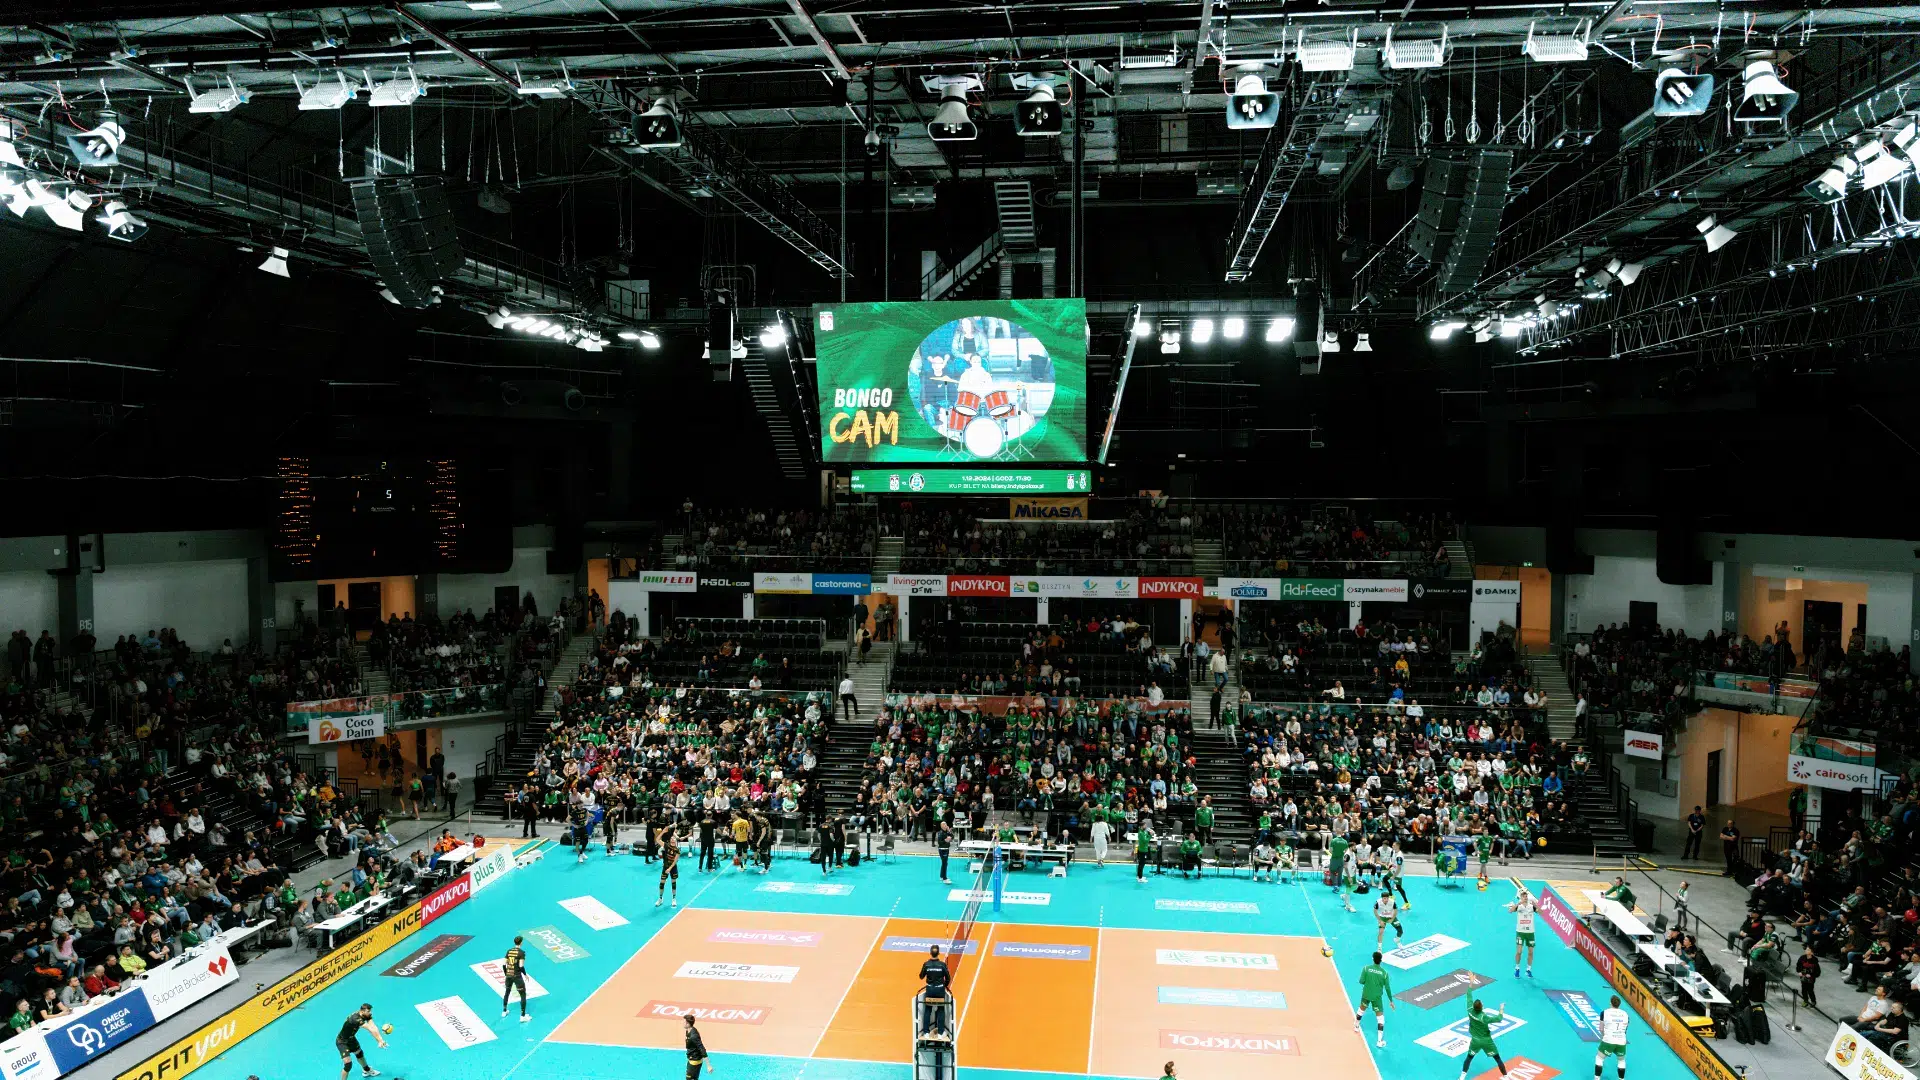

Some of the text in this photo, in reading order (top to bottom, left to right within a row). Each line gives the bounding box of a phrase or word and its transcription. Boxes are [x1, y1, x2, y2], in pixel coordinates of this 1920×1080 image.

[834, 388, 892, 407] BONGO
[829, 410, 899, 448] CAM
[386, 489, 392, 499] 5
[1015, 501, 1083, 518] MIKASA
[815, 580, 862, 589] castorama
[893, 577, 941, 587] livingroom
[951, 580, 1007, 592] INDYKPOL
[1141, 581, 1200, 594] INDYKPOL
[1231, 588, 1266, 597] POLMLEK
[1354, 586, 1405, 595] szynakameble
[262, 618, 275, 629] B15
[1724, 611, 1736, 622] B4
[79, 619, 93, 631] B15
[346, 718, 374, 728] Coco
[346, 729, 374, 738] Palm
[1627, 739, 1659, 752] ABER
[1815, 769, 1869, 784] cairosoft
[473, 863, 495, 887] plus
[422, 881, 470, 921] INDYKPOL
[393, 908, 422, 935] NICE
[1548, 904, 1575, 936] TAURON
[716, 931, 789, 941] TAURON
[1203, 955, 1269, 967] plus
[1576, 930, 1613, 976] INDYKPOL
[262, 935, 375, 1007] CATERING DIETETYCZNY
[153, 970, 211, 1005] Suporta Brokers
[277, 952, 364, 1011] Z WYBOREM MENU
[1615, 967, 1629, 989] TO
[1630, 981, 1647, 1008] FIT
[101, 1008, 131, 1027] OMEGA
[652, 1004, 764, 1020] INDYKPOL
[104, 1018, 127, 1034] LAKE
[1168, 1033, 1290, 1050] INDYKPOL
[11, 1051, 39, 1072] GROUP
[158, 1045, 194, 1080] FIT
